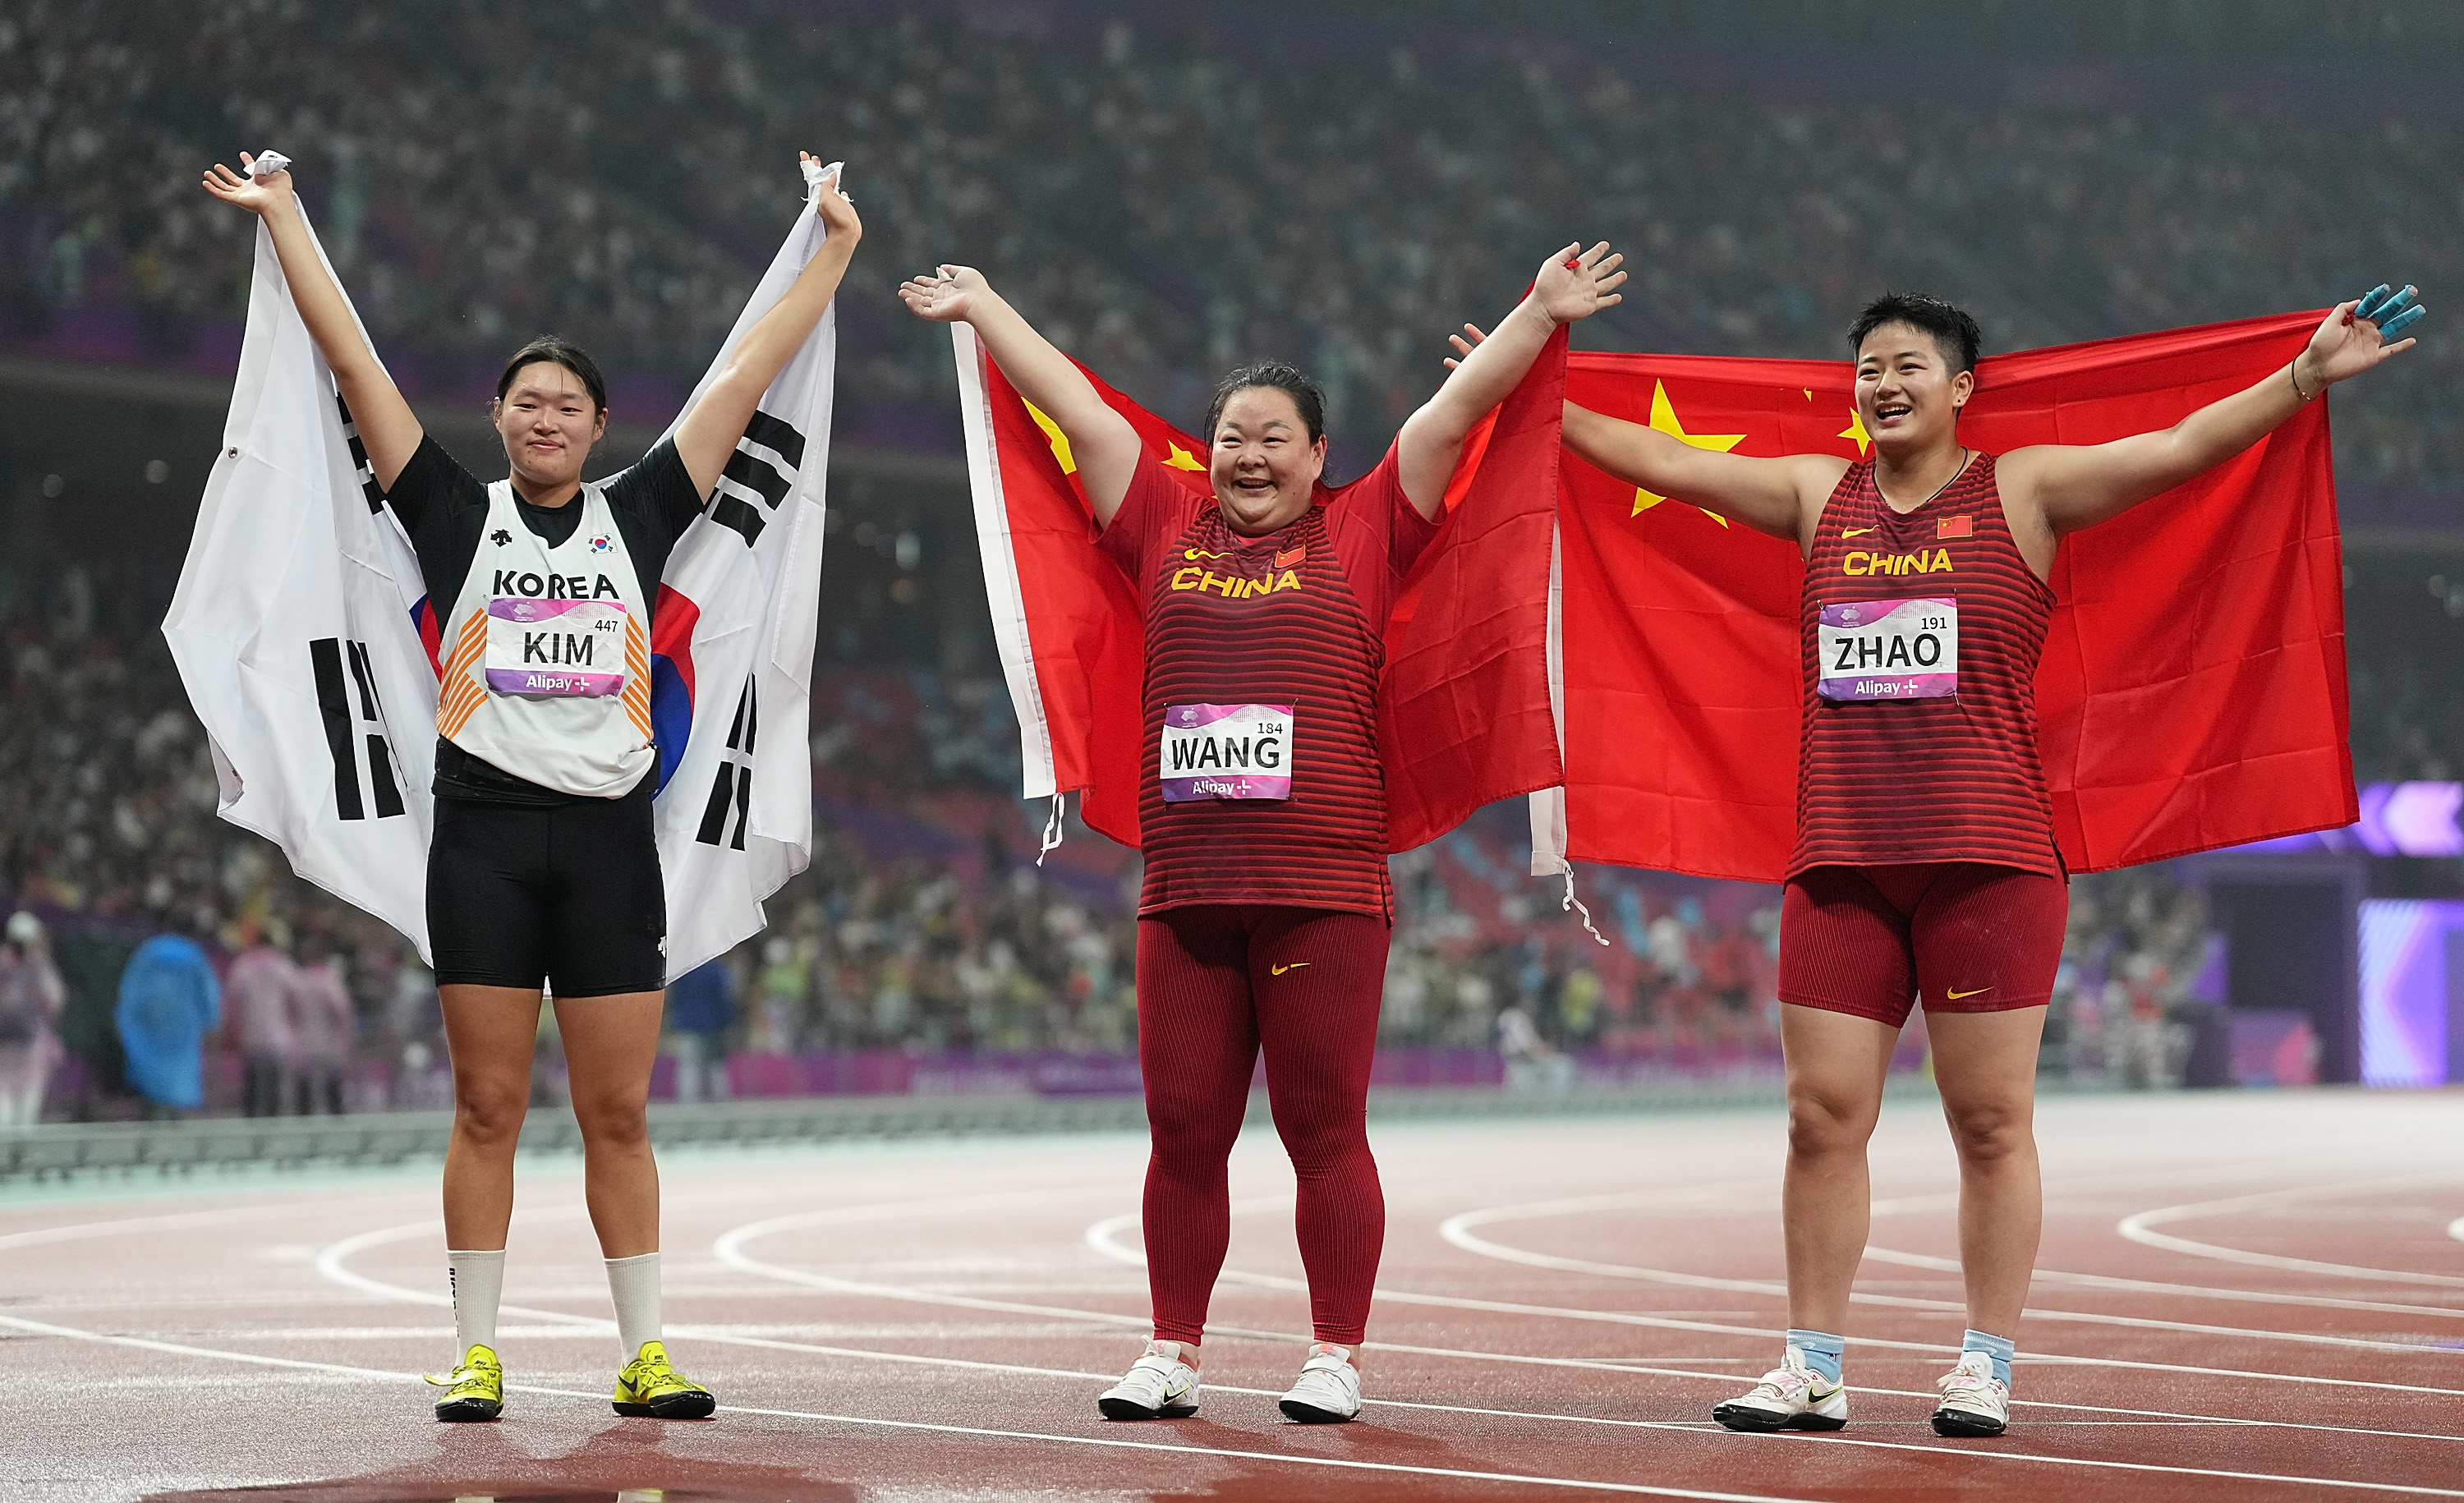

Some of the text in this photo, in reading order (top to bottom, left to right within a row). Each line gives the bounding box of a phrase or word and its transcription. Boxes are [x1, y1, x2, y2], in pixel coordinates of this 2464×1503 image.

[1842, 548, 1954, 576] CHINA
[493, 569, 620, 600] KOREA
[1170, 566, 1302, 599] CHINA
[595, 619, 618, 633] 447
[1921, 617, 1947, 630] 191
[523, 632, 594, 666] KIM
[1834, 633, 1941, 671] ZHAO
[526, 674, 573, 692] Alipay
[1855, 679, 1901, 696] Alipay
[1257, 722, 1283, 734] 184
[1171, 737, 1280, 770] WANG
[1193, 780, 1235, 796] Alipay
